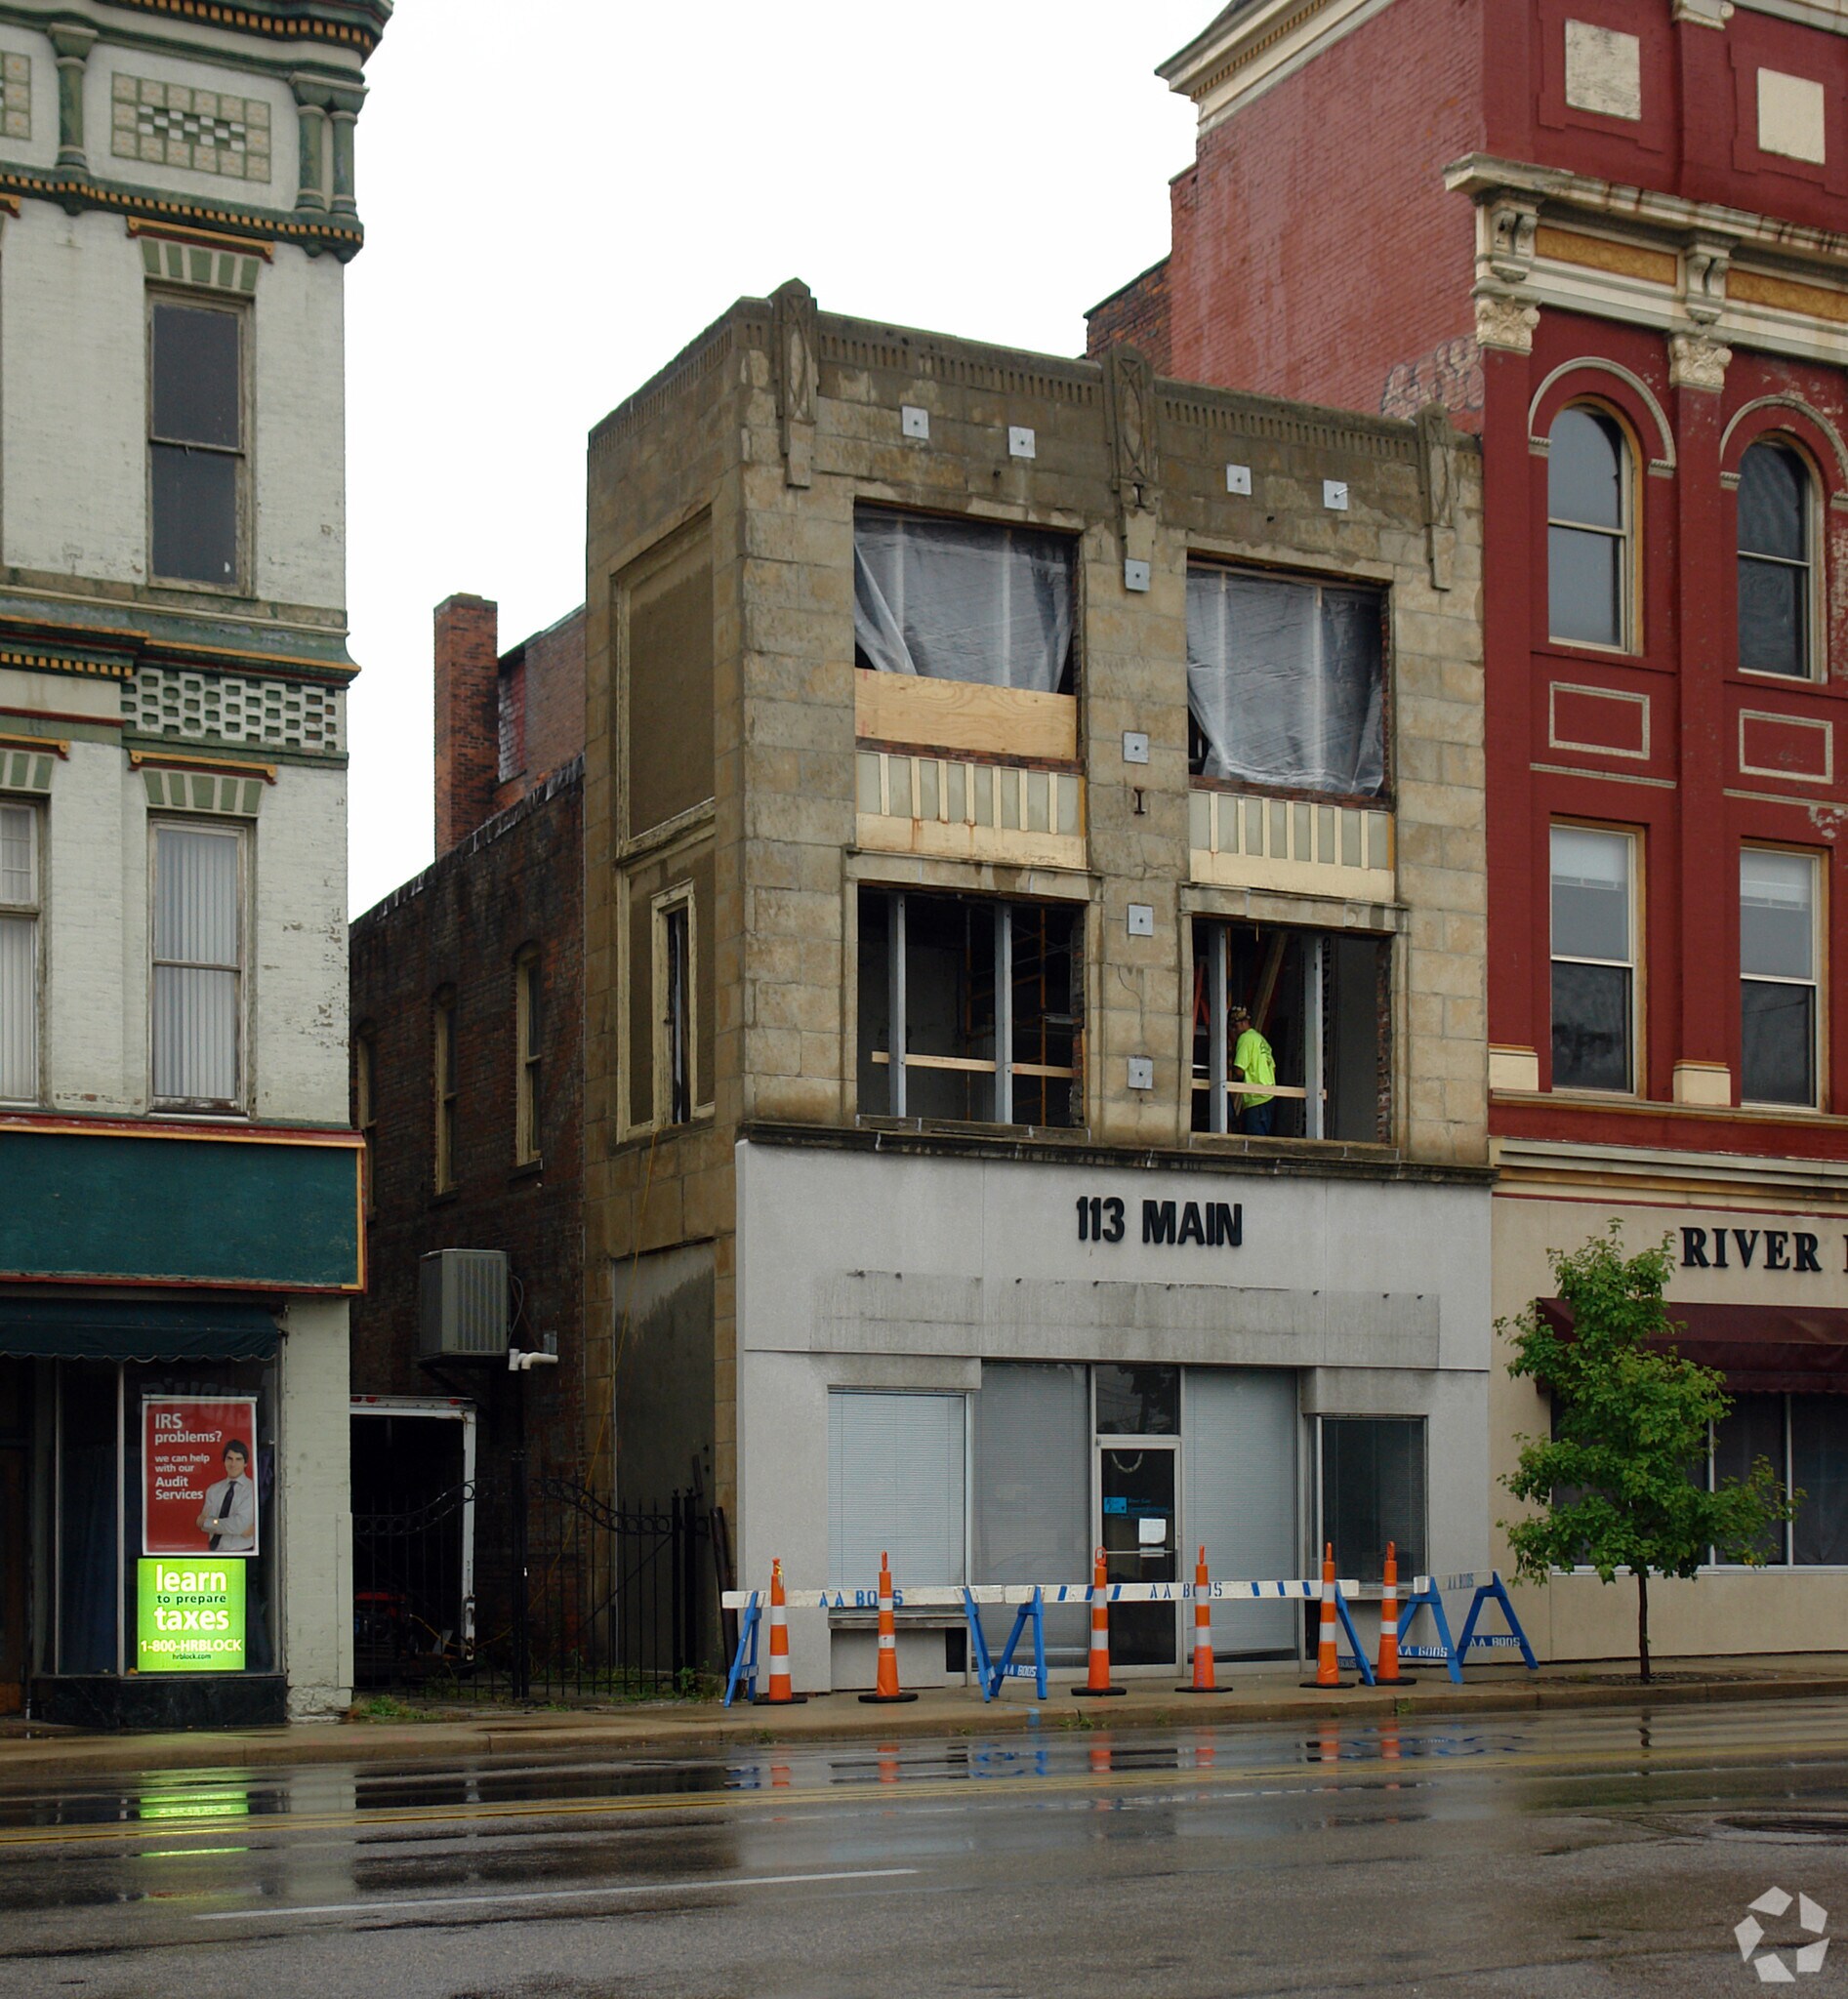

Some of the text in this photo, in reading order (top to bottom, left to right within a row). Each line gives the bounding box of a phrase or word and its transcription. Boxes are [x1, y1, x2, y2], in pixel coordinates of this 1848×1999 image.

[1076, 1196, 1243, 1246] 113 MAIN
[1679, 1226, 1823, 1272] RIVER
[155, 1412, 183, 1429] IRS
[154, 1430, 223, 1445] problems?
[189, 1453, 210, 1464] help
[155, 1463, 177, 1472] with
[155, 1477, 188, 1488] Audit
[155, 1489, 203, 1500] Services
[156, 1564, 226, 1592] learn
[157, 1595, 226, 1606] to prepare
[855, 1589, 904, 1608] BOS
[154, 1606, 229, 1631] taxes
[141, 1639, 242, 1652] 1-800-HRBLOCK
